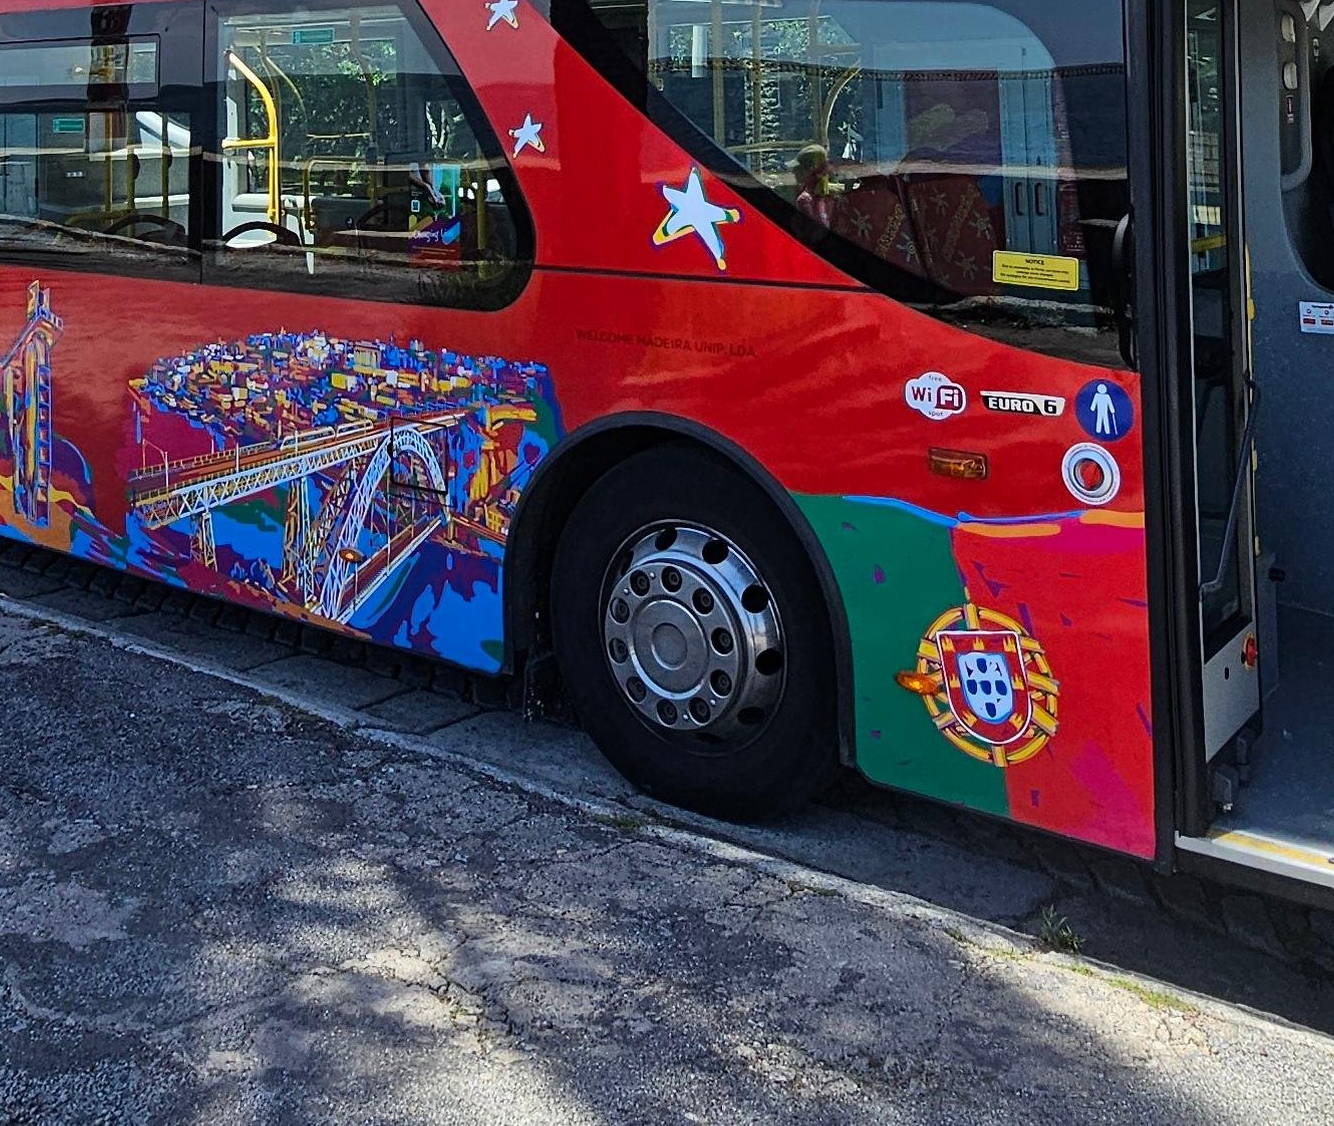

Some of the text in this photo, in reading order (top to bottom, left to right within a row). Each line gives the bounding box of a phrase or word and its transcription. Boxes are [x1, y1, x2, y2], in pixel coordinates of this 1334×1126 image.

[576, 329, 634, 345] WELCOME
[637, 336, 692, 352] MADEIRA
[988, 397, 1057, 414] EURO 6
